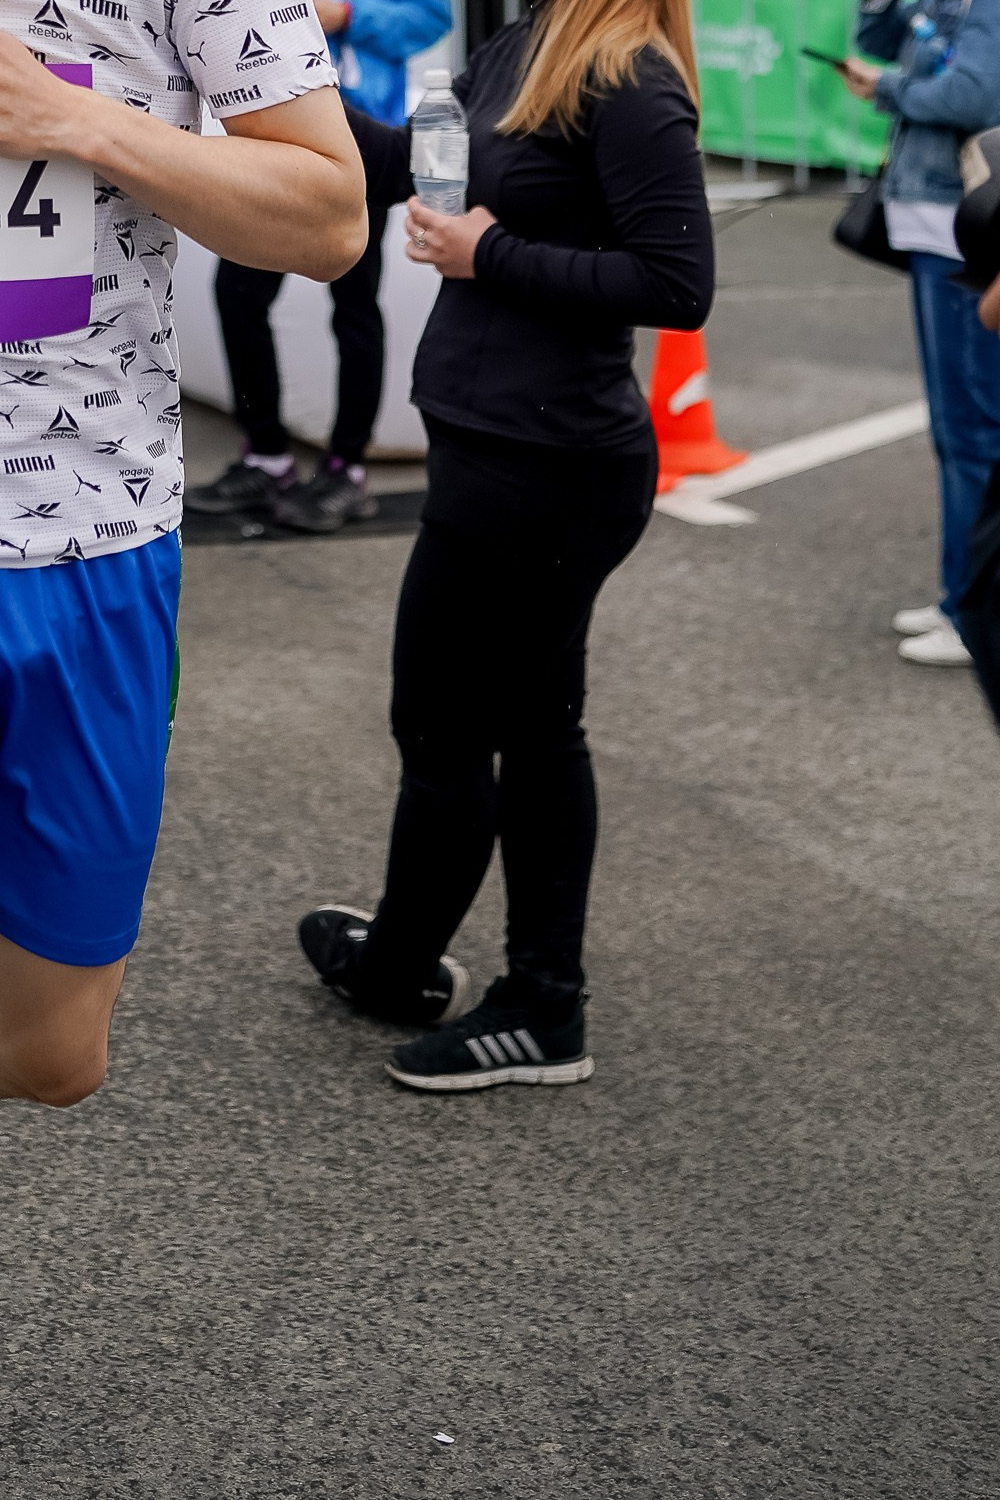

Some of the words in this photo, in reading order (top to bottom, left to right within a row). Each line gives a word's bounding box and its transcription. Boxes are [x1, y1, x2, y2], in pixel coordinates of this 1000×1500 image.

[270, 3, 309, 27] PUMA
[28, 24, 73, 42] Reebok
[235, 53, 281, 73] Reebok
[109, 339, 137, 355] Reebok
[84, 389, 122, 410] PUMA
[40, 431, 82, 441] Reebok
[3, 454, 56, 475] PUMA
[118, 466, 154, 478] Reebok
[93, 520, 138, 539] PUMA
